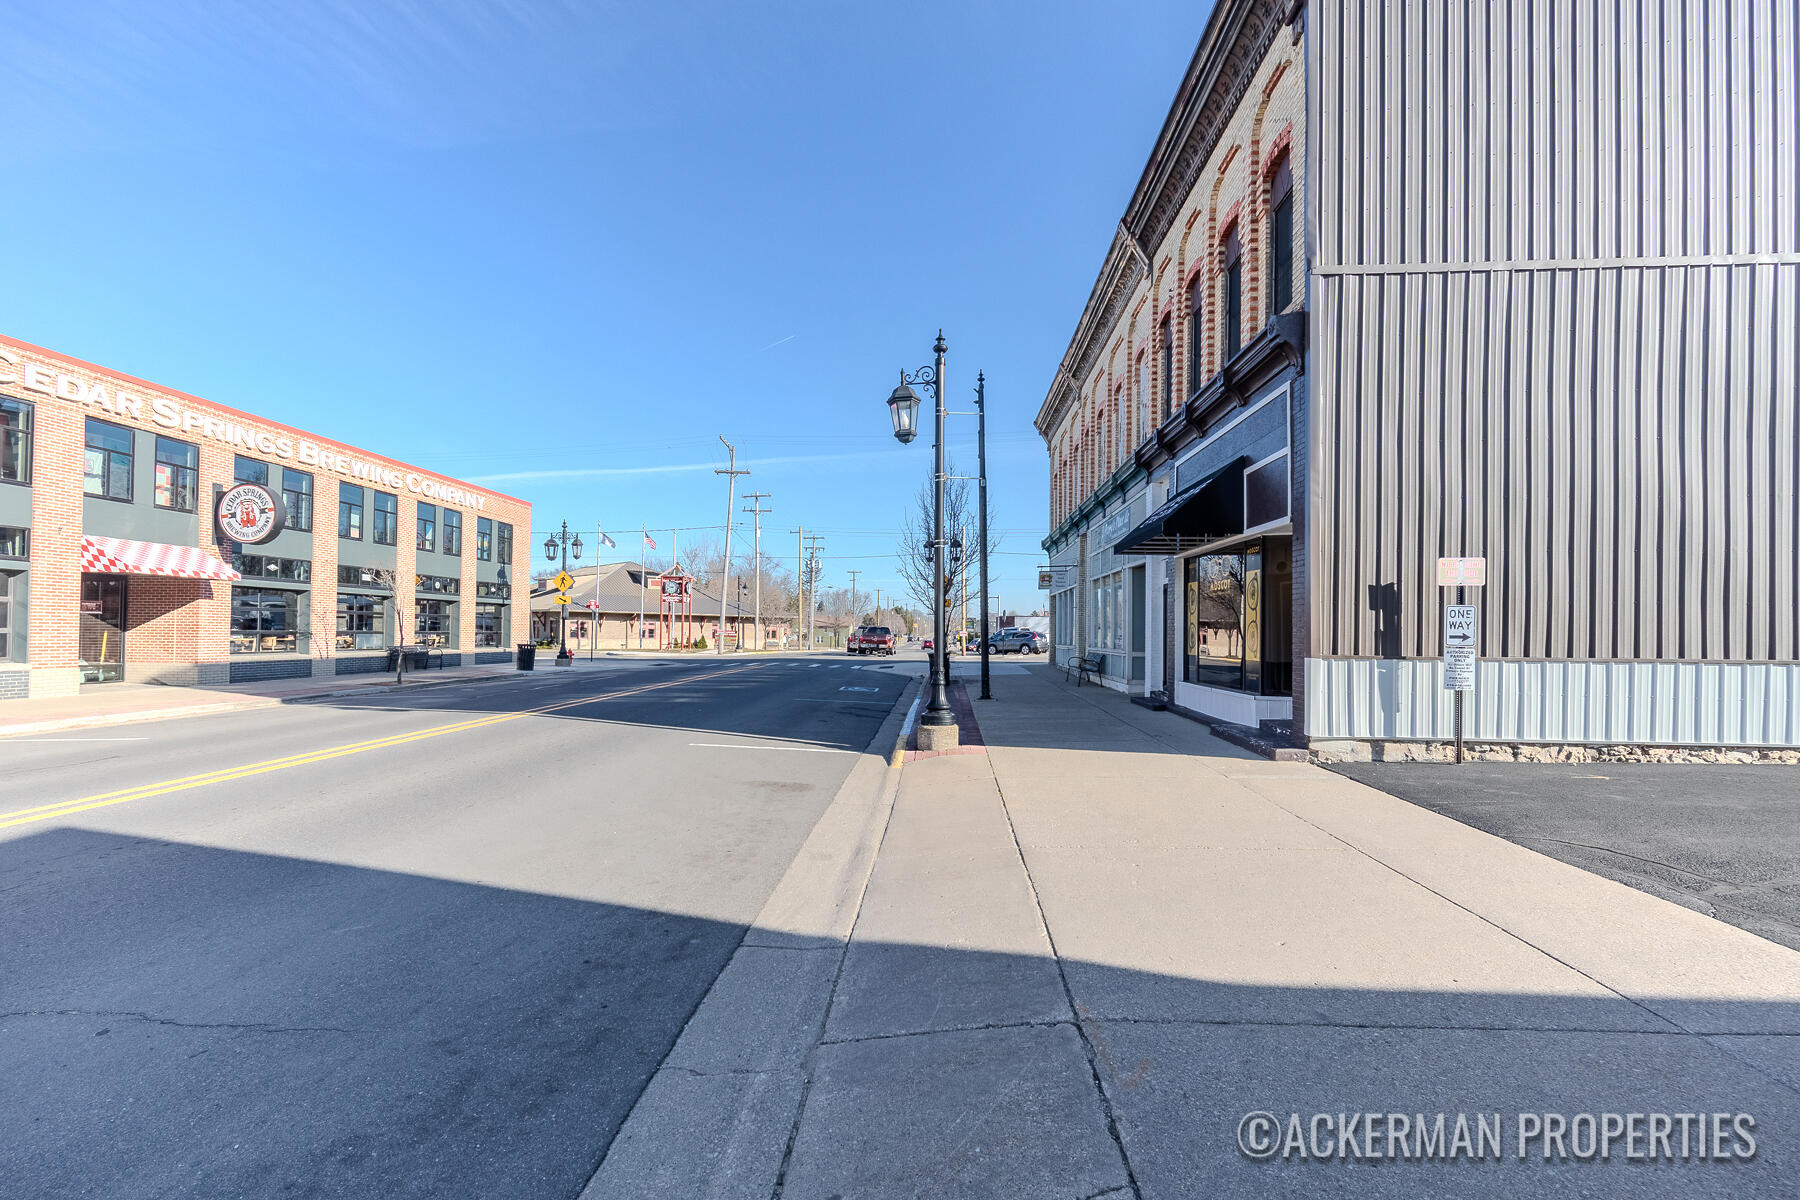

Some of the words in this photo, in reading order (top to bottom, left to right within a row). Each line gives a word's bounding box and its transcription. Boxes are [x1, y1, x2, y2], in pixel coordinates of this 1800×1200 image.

[152, 399, 294, 459] SPRINGS
[299, 440, 402, 488] BREWING
[406, 473, 486, 510] COMPANY
[225, 490, 243, 511] CEDAR
[243, 488, 269, 507] SPRINGS
[226, 521, 250, 538] BREWING
[250, 516, 271, 538] COMPANY
[1448, 620, 1473, 630] WAY
[1449, 609, 1473, 619] ONE
